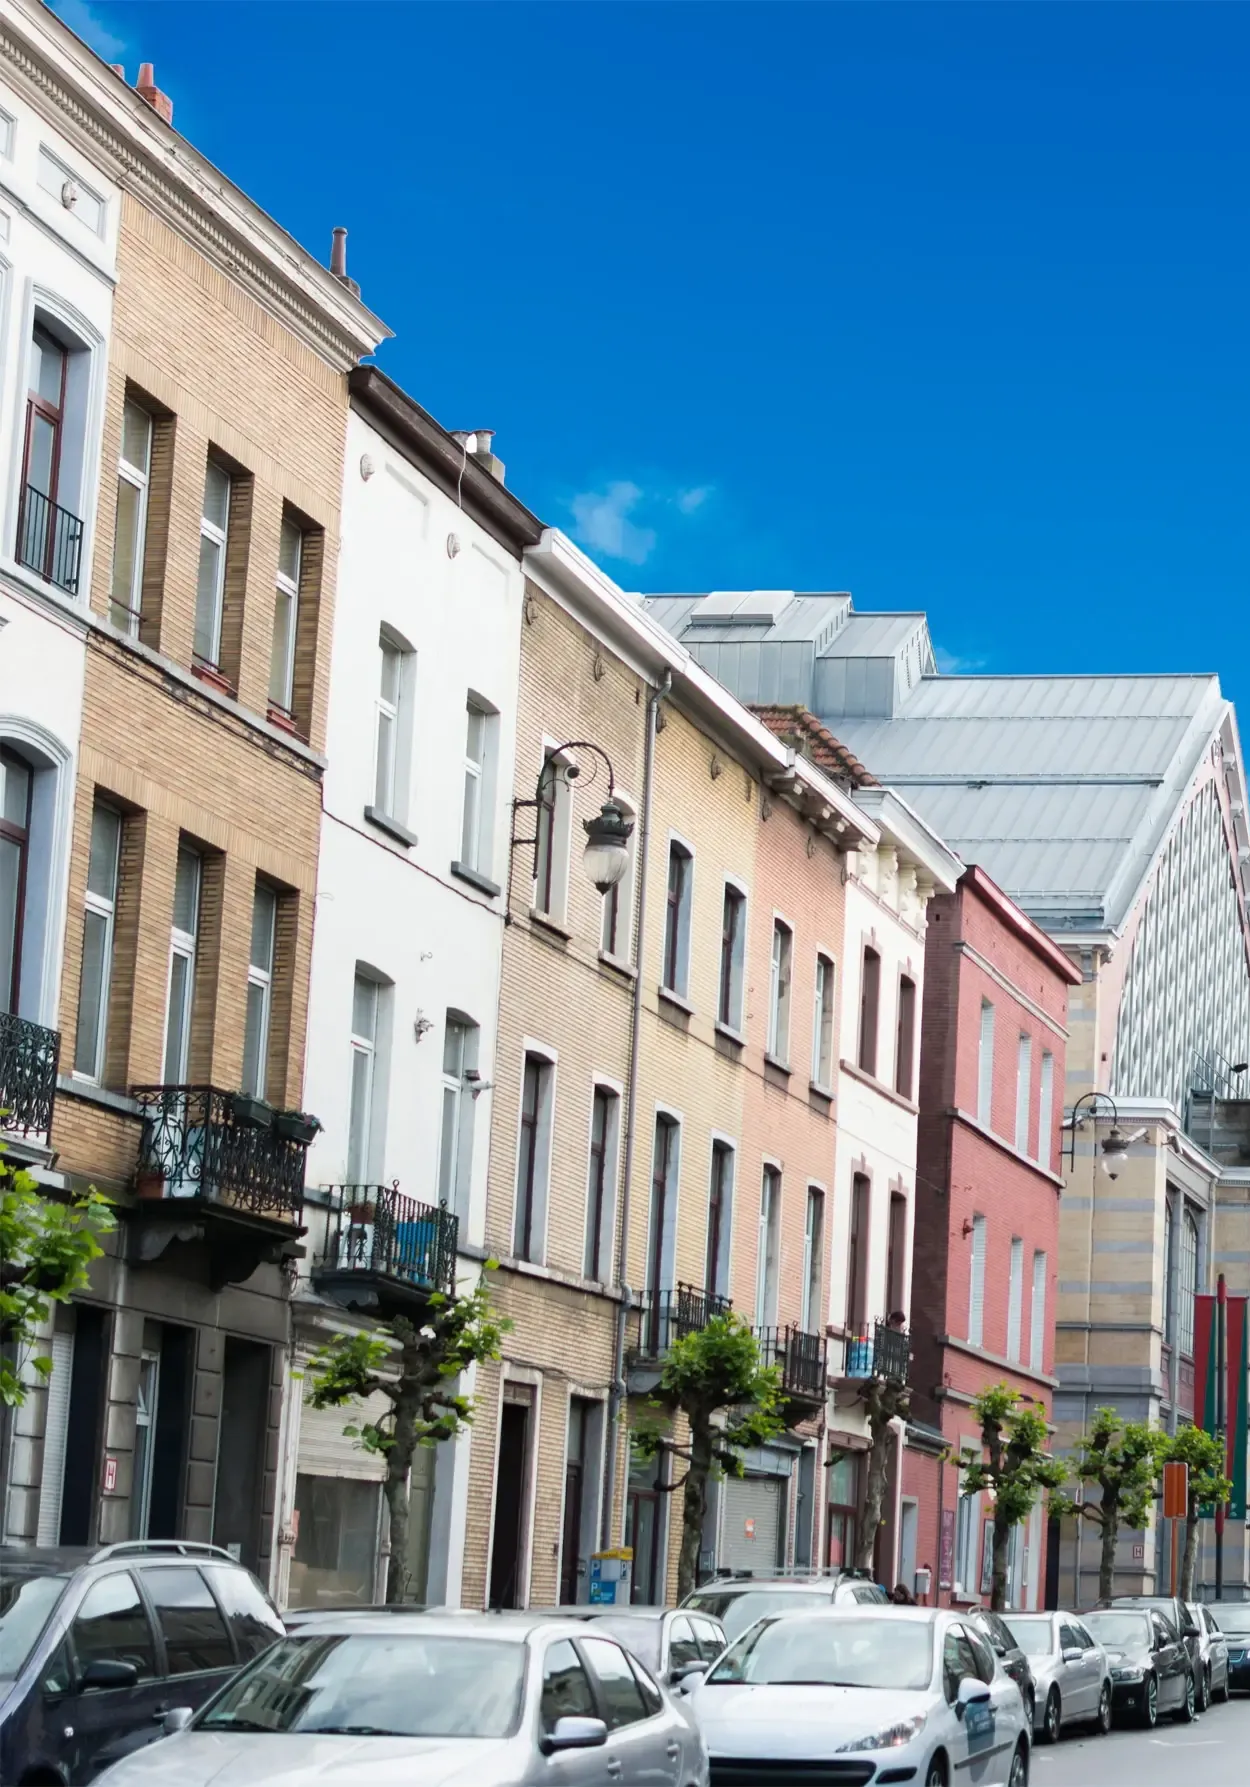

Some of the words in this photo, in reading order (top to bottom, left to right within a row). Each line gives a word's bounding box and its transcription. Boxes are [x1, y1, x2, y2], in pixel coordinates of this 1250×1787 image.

[107, 1463, 115, 1485] H
[1136, 1548, 1142, 1557] H
[592, 1561, 600, 1577] P
[591, 1582, 598, 1595] P
